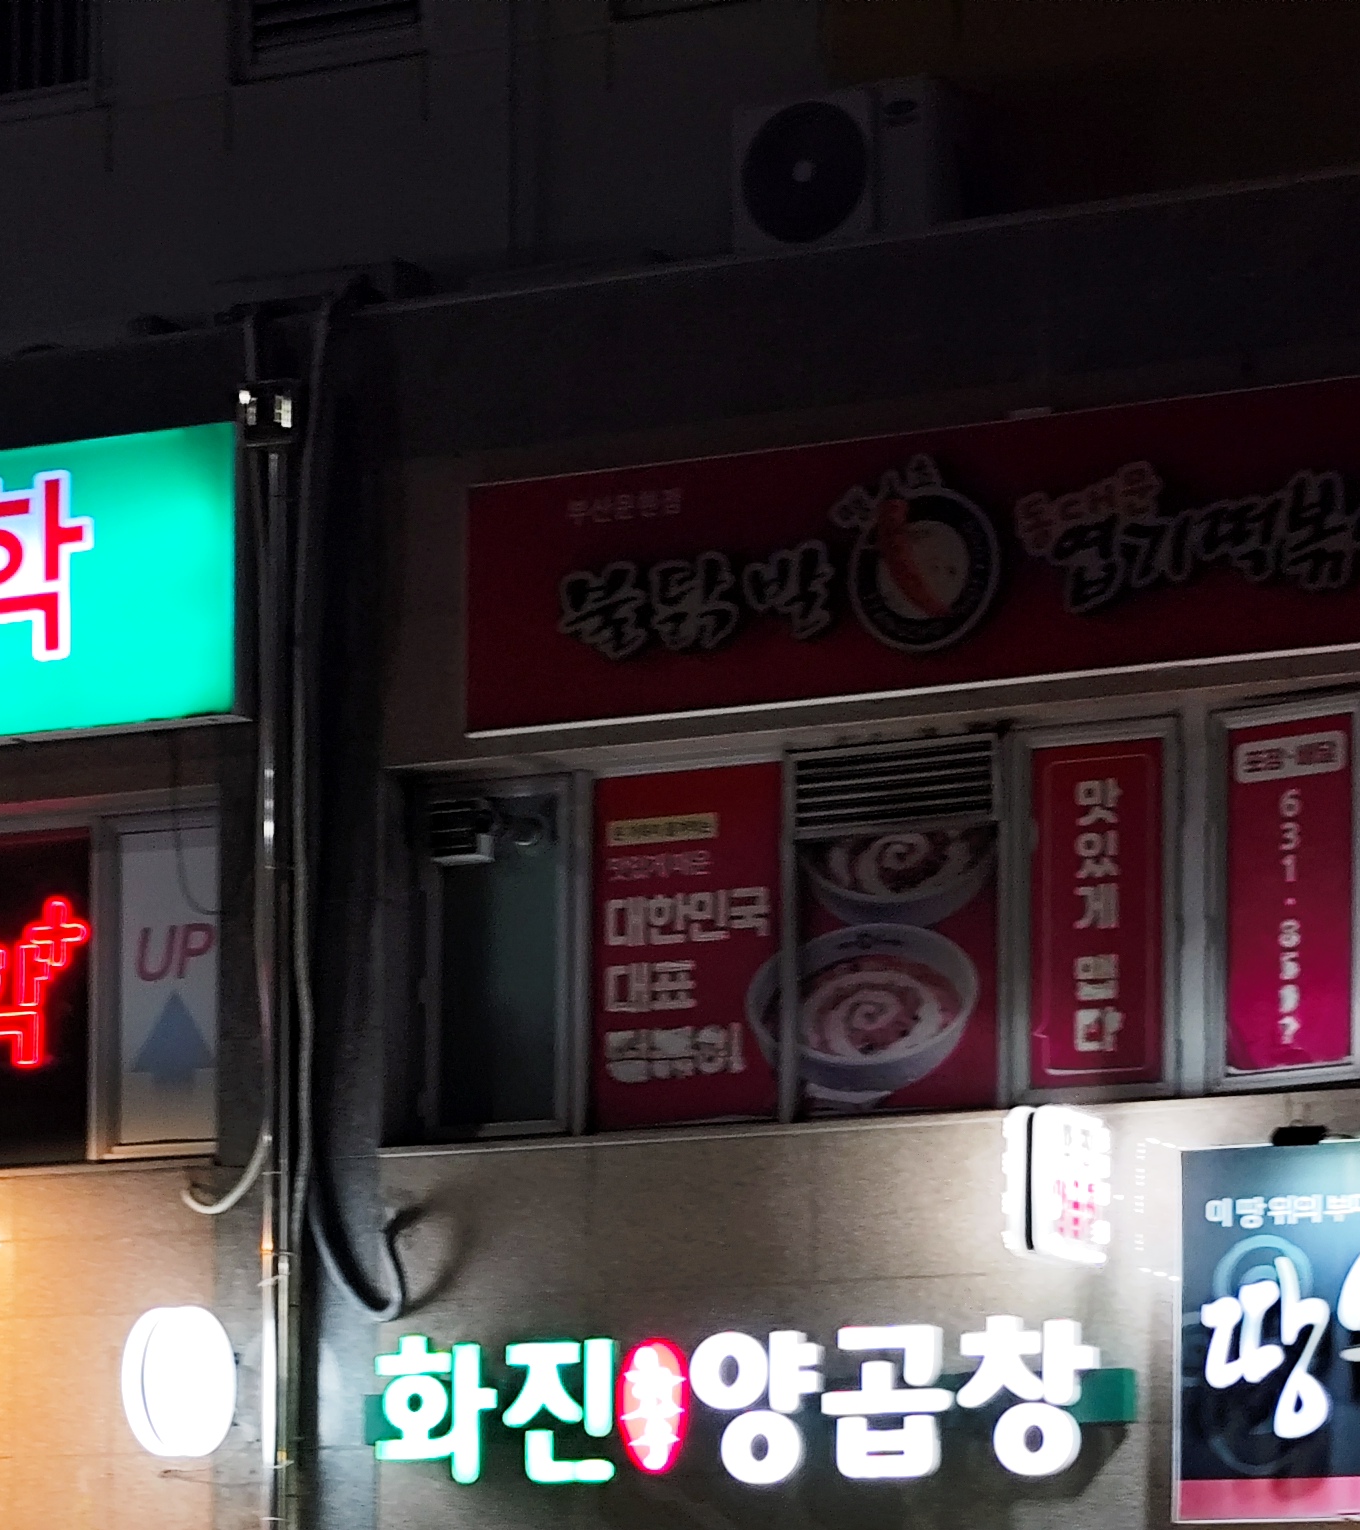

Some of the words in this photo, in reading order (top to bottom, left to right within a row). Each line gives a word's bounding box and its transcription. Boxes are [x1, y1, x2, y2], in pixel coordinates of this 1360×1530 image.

[1072, 777, 1123, 930] 맛있게
[604, 886, 771, 947] 대한민국
[133, 923, 215, 983] UP
[604, 960, 698, 1014] 대표
[373, 1334, 620, 1484] 화진
[687, 1316, 1101, 1486] 양곱창
